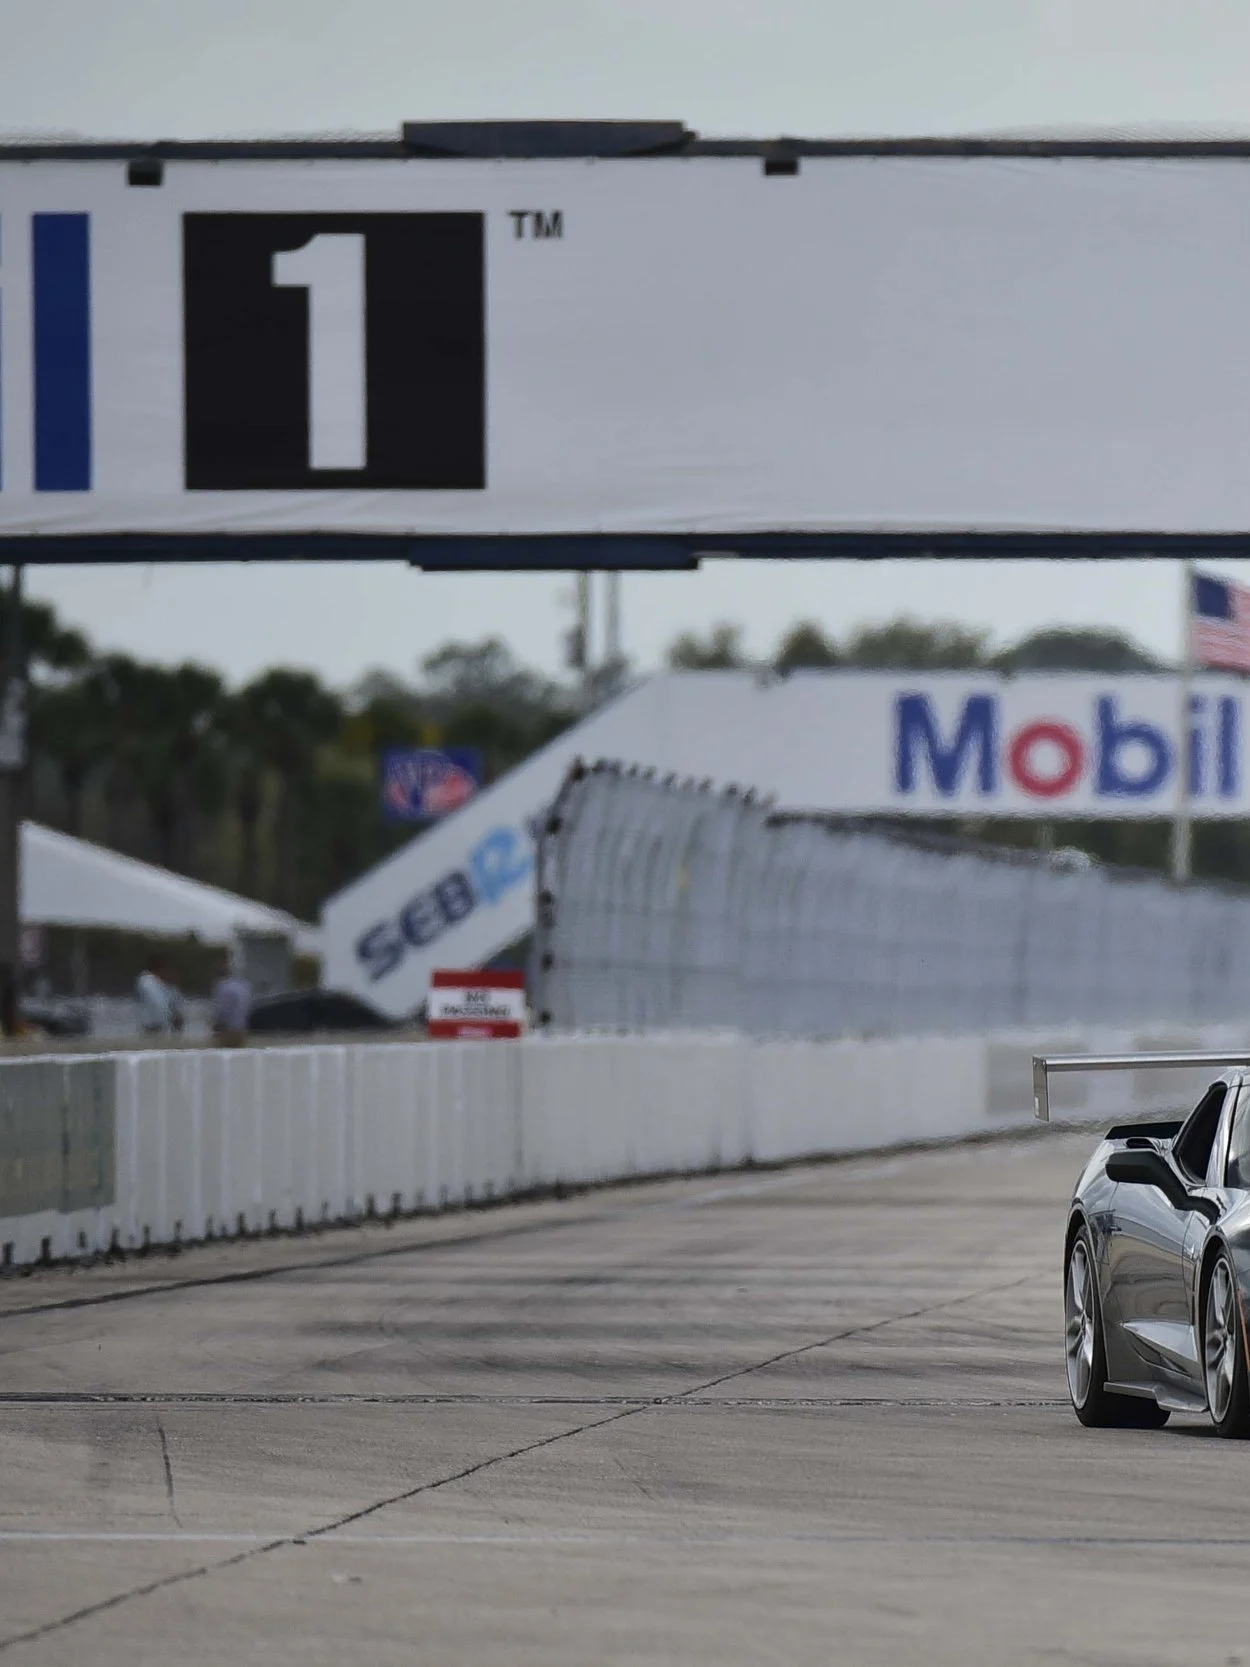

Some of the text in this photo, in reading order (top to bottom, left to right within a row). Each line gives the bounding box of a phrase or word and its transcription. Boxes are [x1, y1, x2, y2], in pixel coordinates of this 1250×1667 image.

[271, 232, 367, 470] 1
[506, 209, 564, 240] TM
[894, 690, 1243, 798] Mobil
